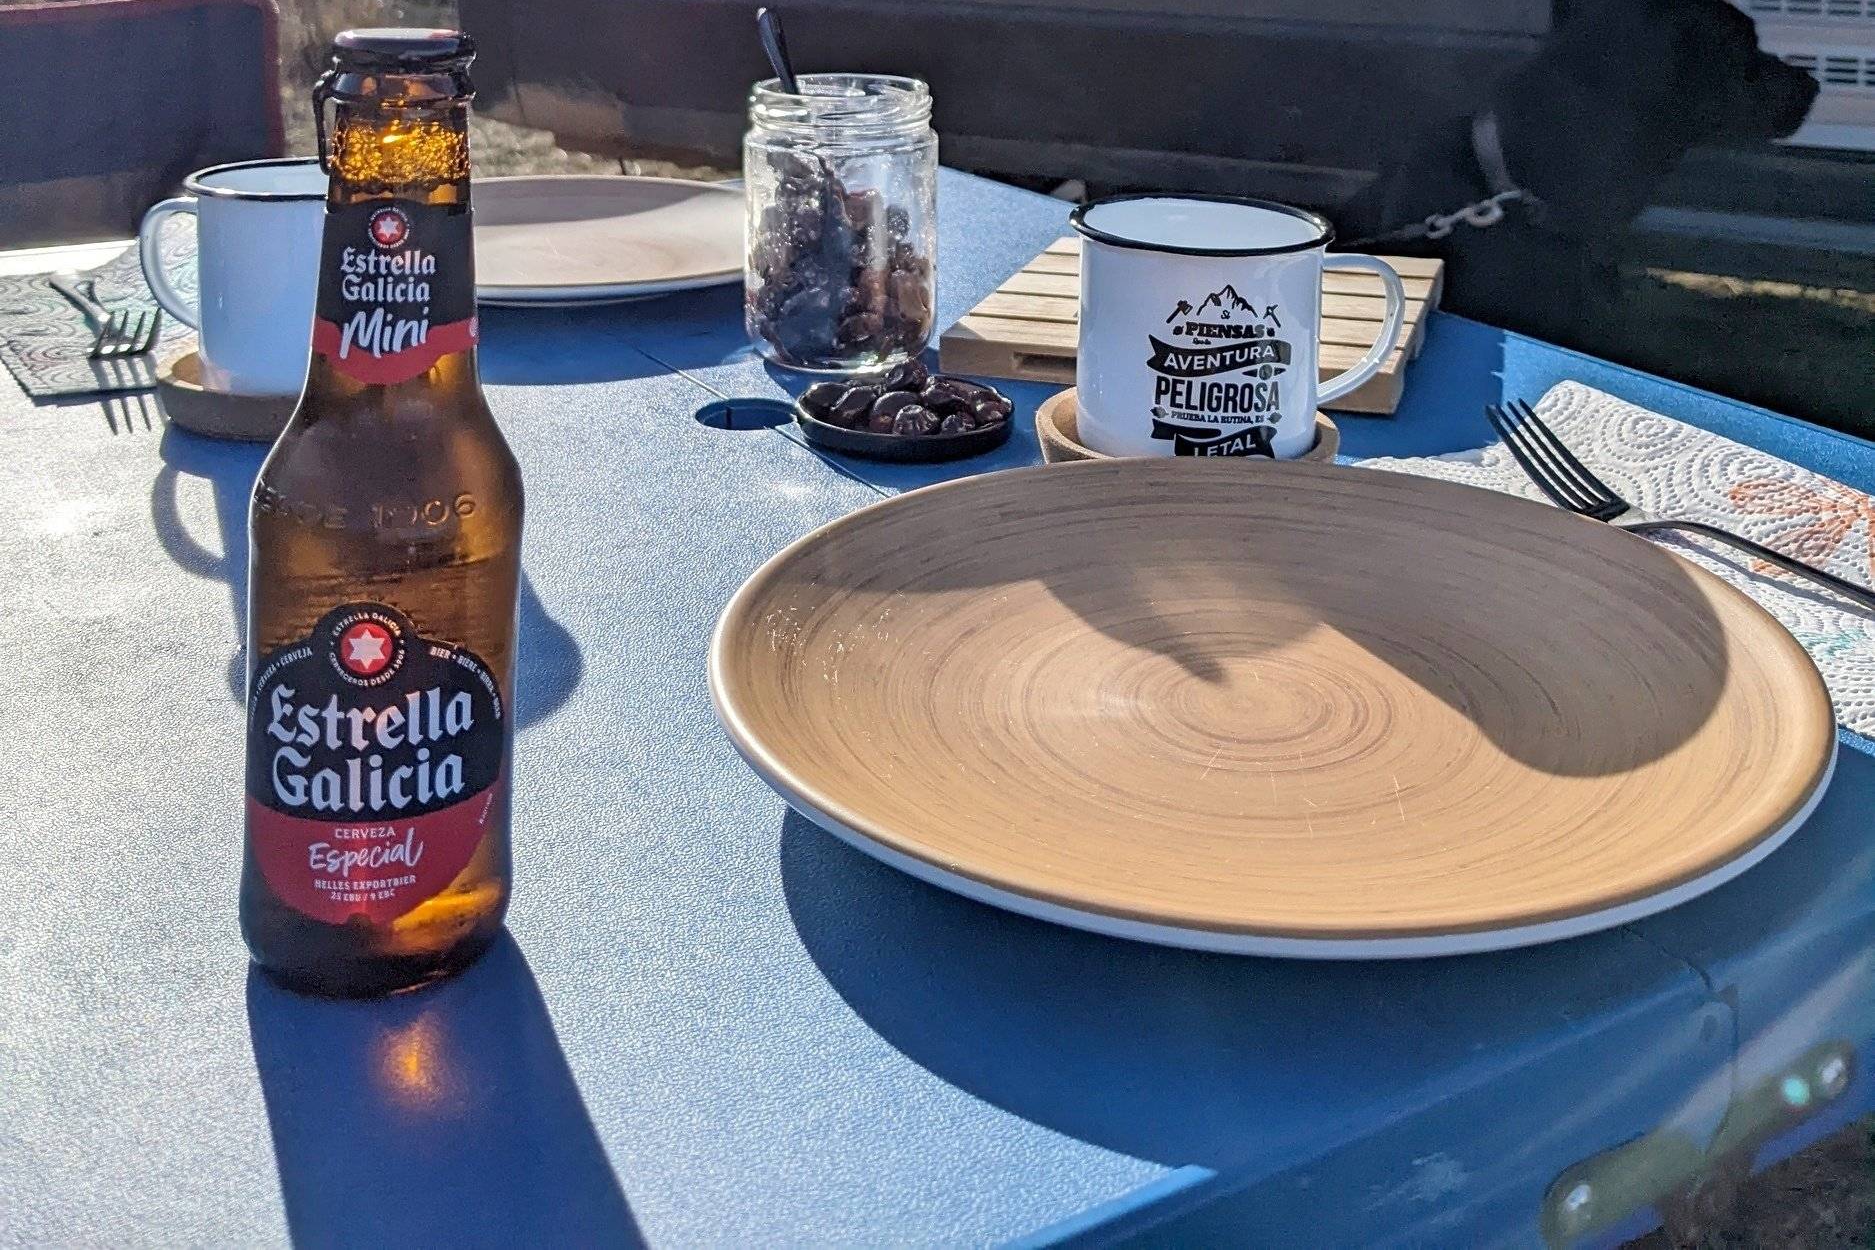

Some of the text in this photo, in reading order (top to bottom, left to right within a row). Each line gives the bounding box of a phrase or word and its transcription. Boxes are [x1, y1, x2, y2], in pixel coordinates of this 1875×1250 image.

[340, 246, 437, 276] Estrella
[341, 274, 431, 302] Galicia
[339, 306, 430, 360] Mini
[1185, 321, 1265, 338] PIENSAS
[1163, 345, 1275, 371] AVENTURA
[1154, 374, 1280, 413] PELIGROSA
[1171, 411, 1206, 423] PRUEBA
[1206, 415, 1219, 424] LA
[332, 612, 402, 637] ESTRELLA GALICIA
[267, 684, 475, 752] Estrella
[273, 746, 466, 813] Galicia
[334, 826, 397, 840] CERVEZA
[308, 827, 424, 878] Especial
[313, 874, 418, 891] HELLES EXPORTBIER
